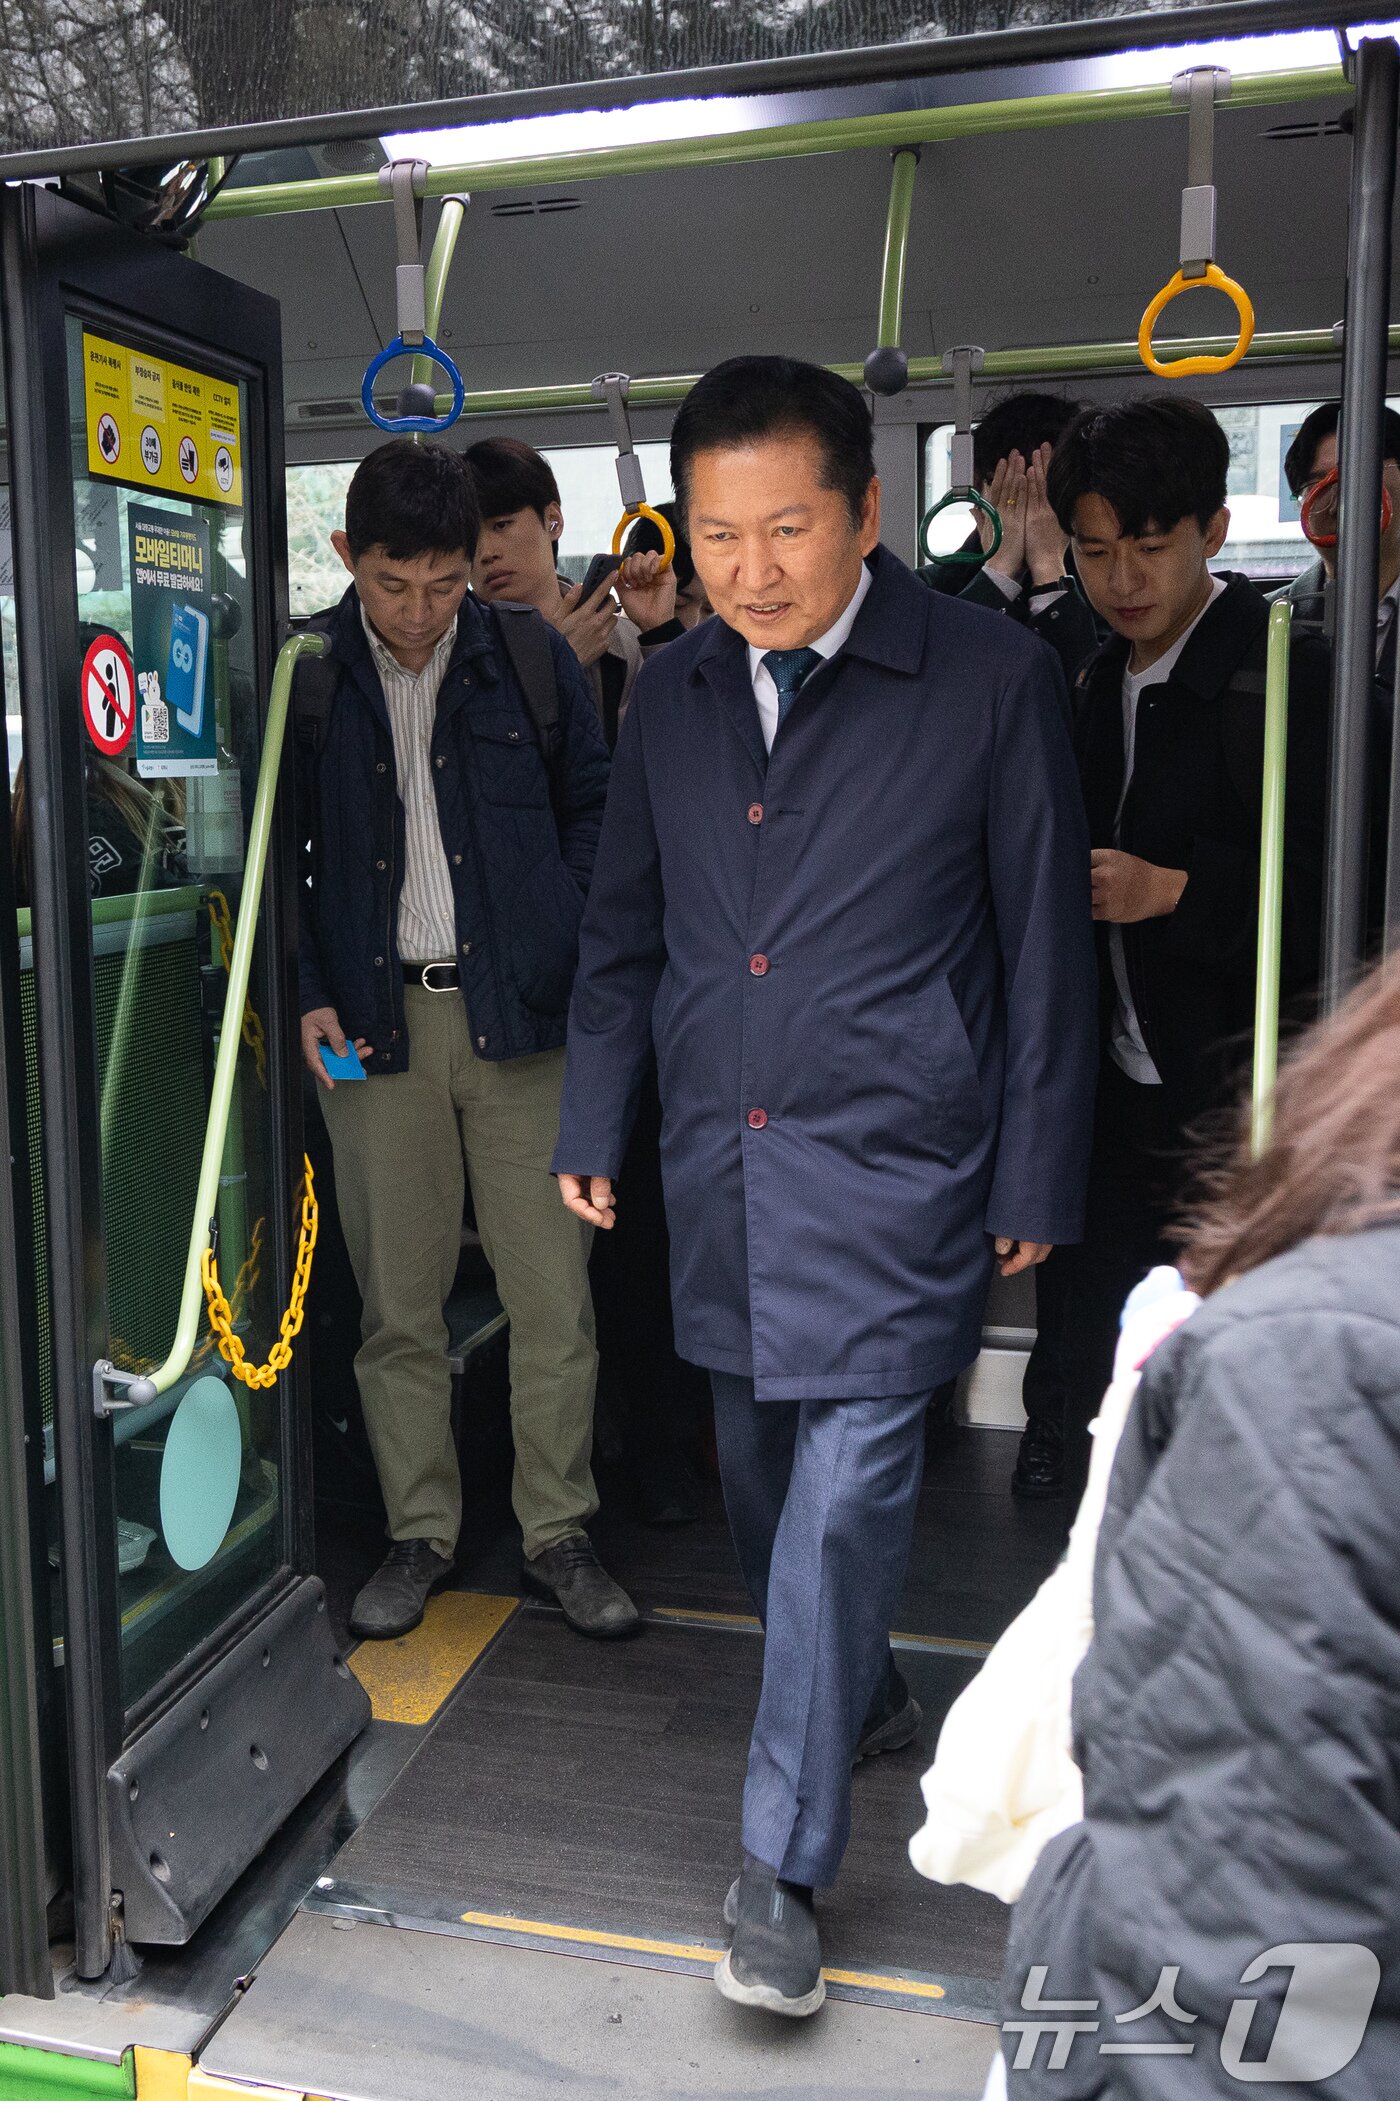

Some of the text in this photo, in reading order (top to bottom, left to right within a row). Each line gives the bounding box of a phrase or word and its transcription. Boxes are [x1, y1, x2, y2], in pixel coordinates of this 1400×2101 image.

[135, 366, 161, 383] 부정승차 금지
[213, 393, 223, 403] CCTV
[144, 449, 158, 464] 부가금
[135, 535, 203, 574] 모바일티머니
[136, 567, 203, 593] 앱에서 무료 발급하세요!
